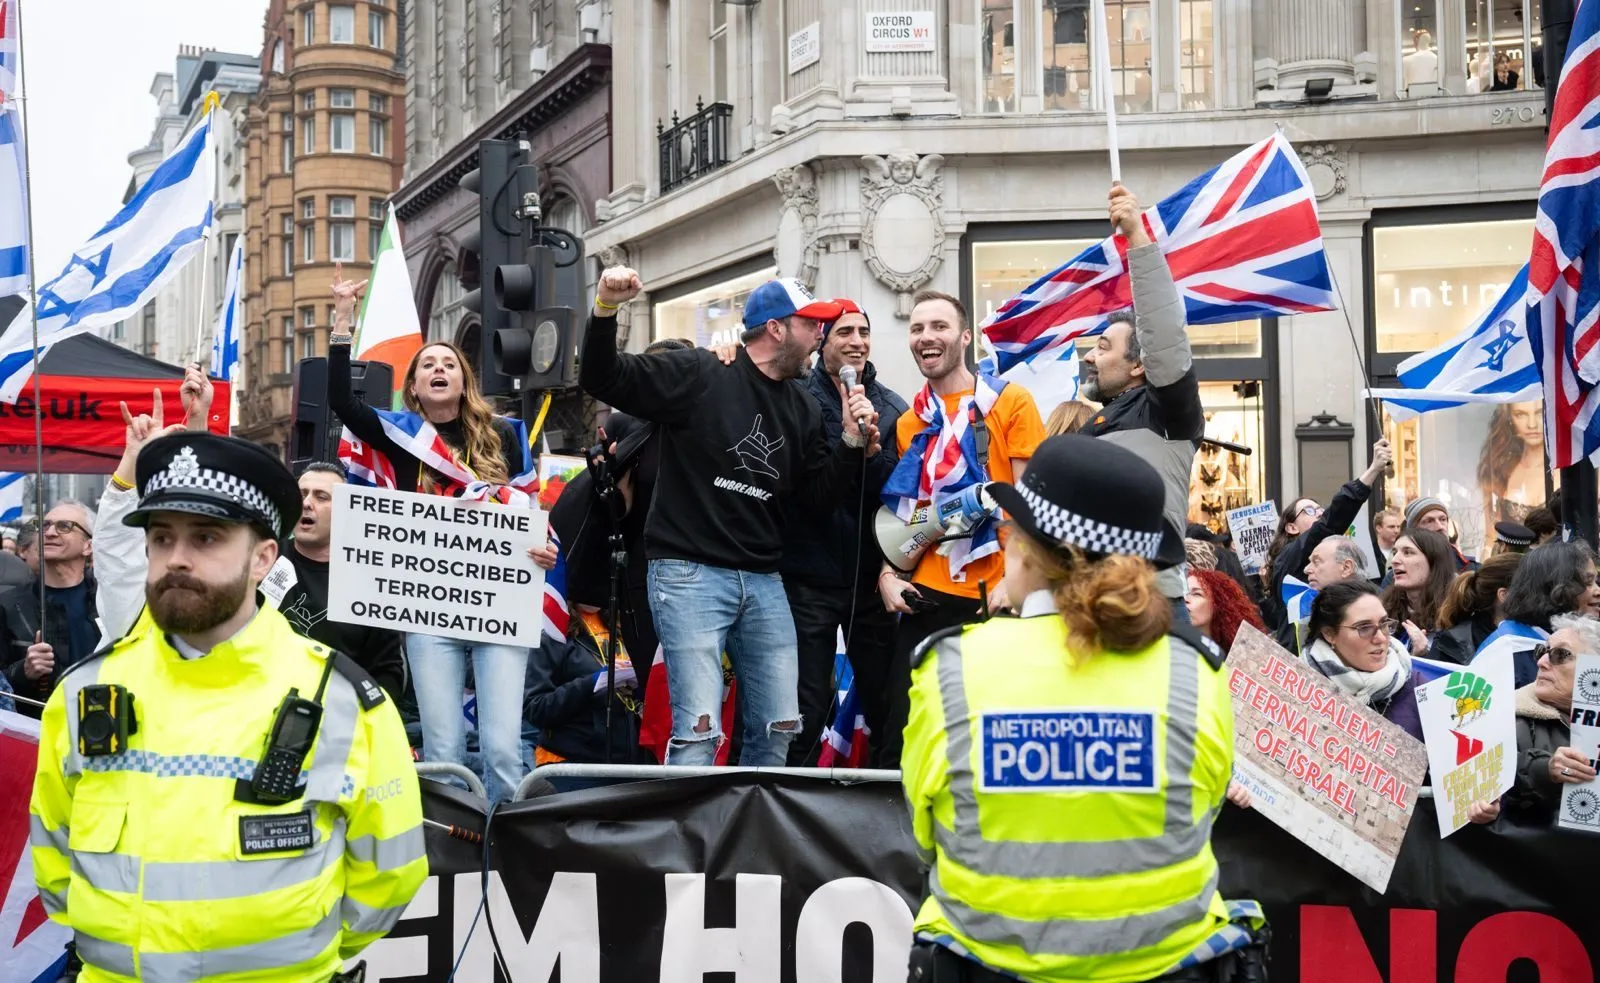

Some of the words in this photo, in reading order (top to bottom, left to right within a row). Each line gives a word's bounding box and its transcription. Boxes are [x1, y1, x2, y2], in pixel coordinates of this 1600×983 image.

[872, 16, 912, 26] OXFORD
[872, 28, 910, 38] CIRCUS
[913, 28, 928, 38] W1
[1491, 107, 1536, 125] 270
[350, 494, 404, 516] FREE
[412, 502, 530, 532] PALESTINE
[1231, 503, 1271, 520] JERUSALEM
[364, 522, 426, 545] FROM
[434, 532, 512, 556] HAMAS
[1240, 525, 1270, 538] ETERNAL
[343, 546, 384, 567] THE
[391, 553, 532, 585] PROSCRIBED
[375, 577, 497, 607] TERRORIST
[351, 601, 517, 637] ORGANISATION
[1260, 654, 1383, 751] JERUSALEM
[992, 718, 1143, 739] METROPOLITAN
[1228, 667, 1319, 750] ETERNAL
[1322, 735, 1408, 810] CAPITAL
[992, 741, 1143, 781] POLICE
[1254, 727, 1288, 761] OF
[1285, 750, 1358, 815] ISRAEL
[264, 818, 308, 828] METROPOLITAN
[270, 826, 303, 835] POLICE
[245, 839, 275, 850] POLICE
[277, 835, 311, 849] OFFICER
